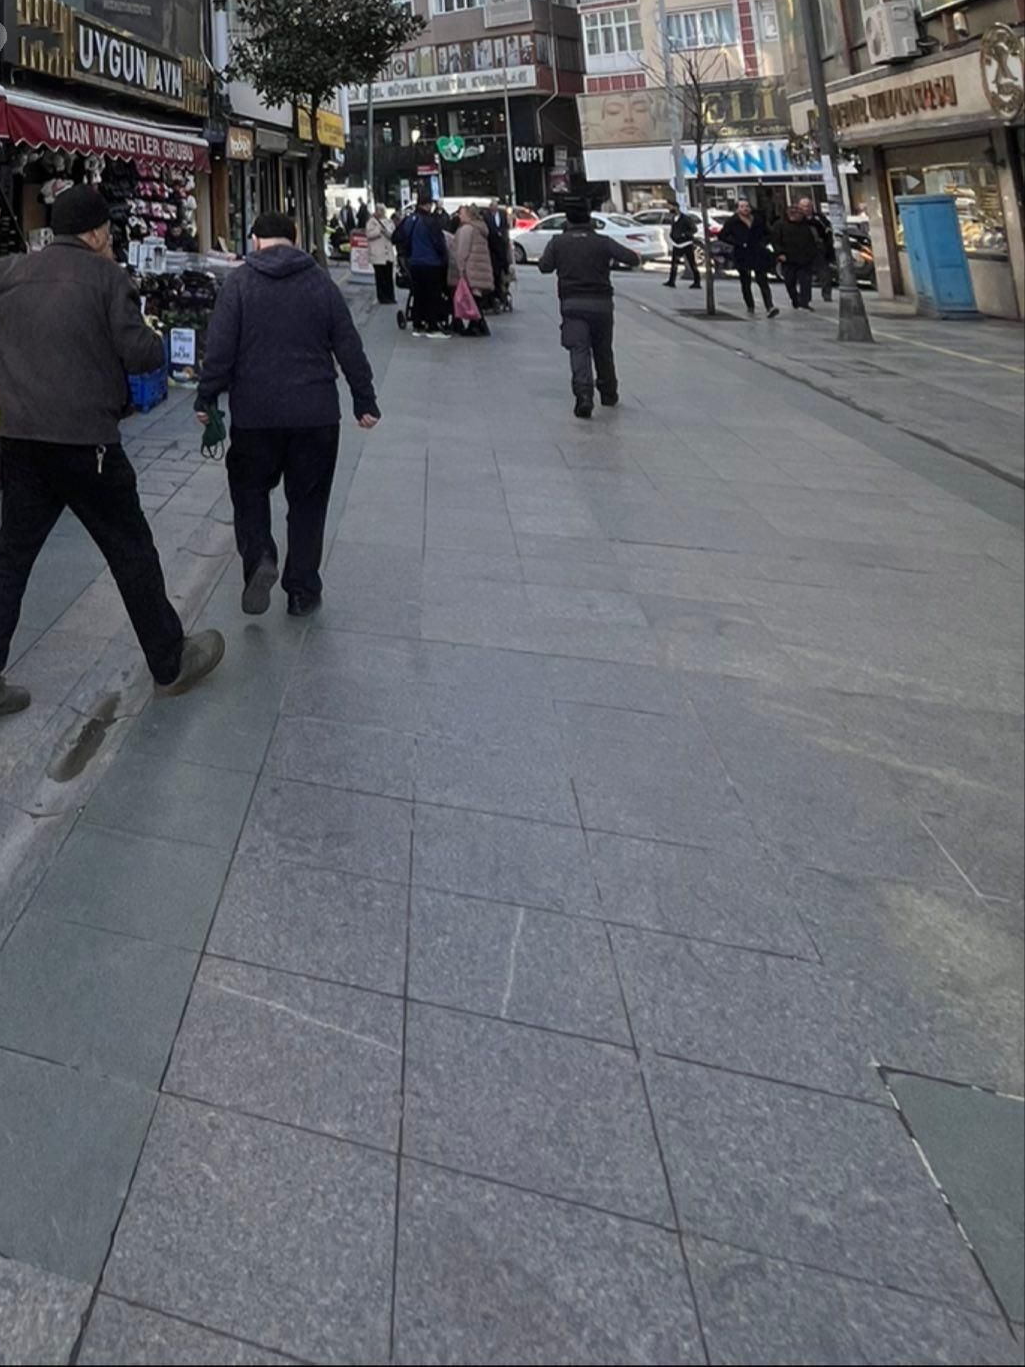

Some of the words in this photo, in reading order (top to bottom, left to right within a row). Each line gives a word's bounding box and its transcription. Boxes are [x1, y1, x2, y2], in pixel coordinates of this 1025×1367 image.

[78, 22, 149, 85] UYGUN
[45, 115, 91, 147] VATAN
[93, 127, 160, 156] MARKETLER
[162, 140, 195, 163] GRUBU
[513, 146, 544, 164] COFFY
